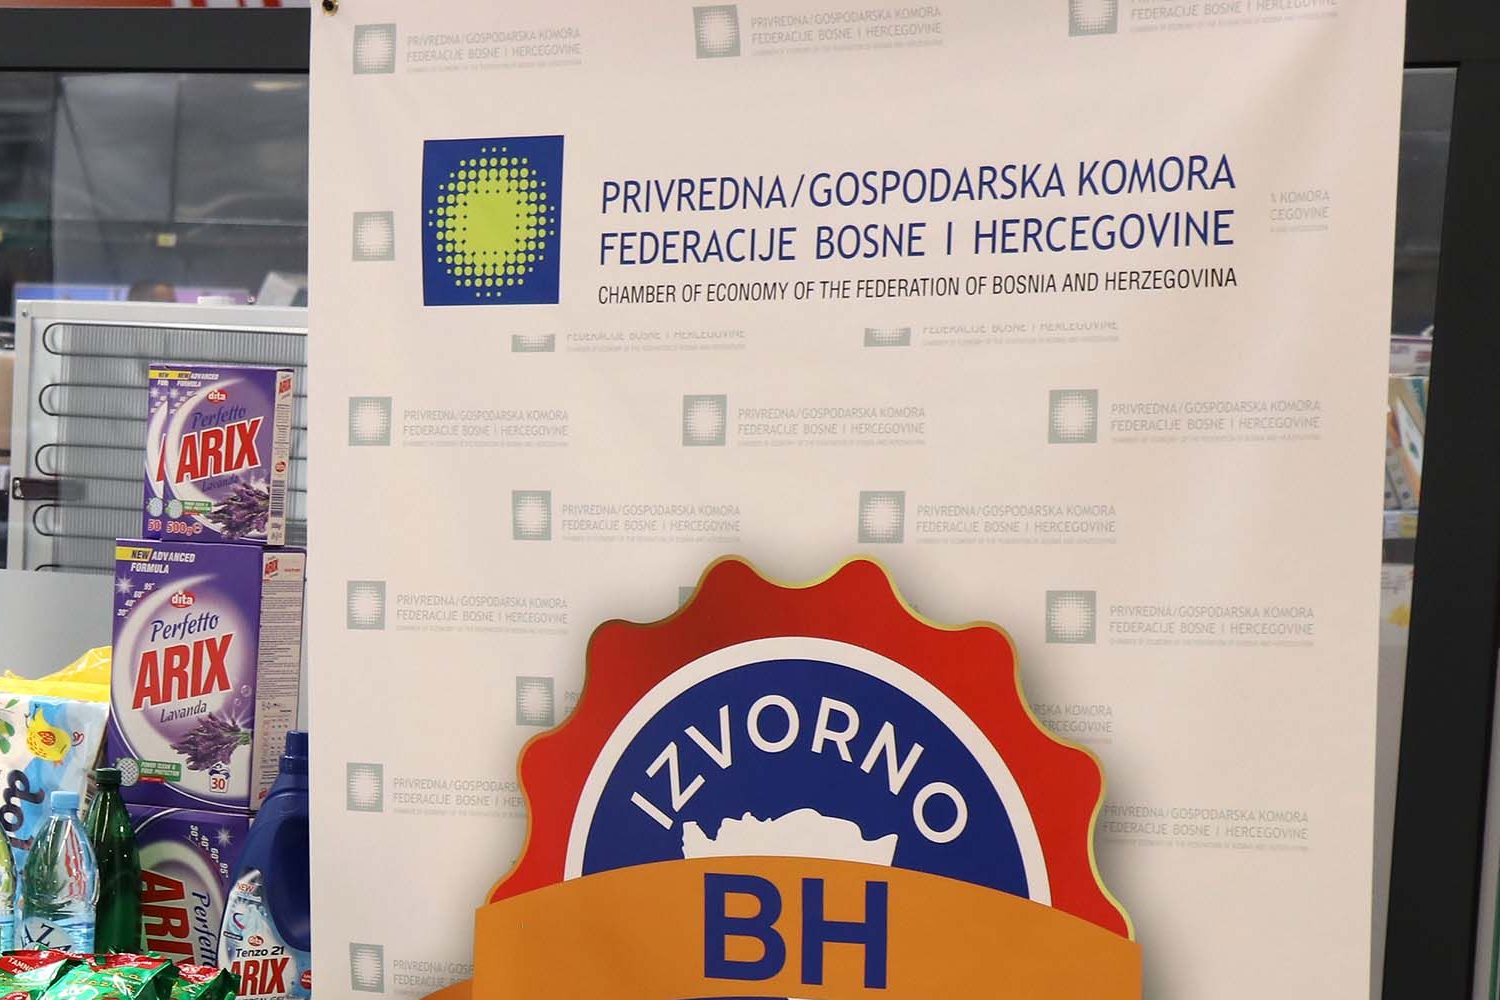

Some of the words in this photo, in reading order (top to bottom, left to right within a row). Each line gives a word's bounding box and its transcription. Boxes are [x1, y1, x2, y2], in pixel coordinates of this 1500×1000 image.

[602, 162, 1066, 214] PRIVREDNA/GOSPODARSKA
[1078, 153, 1236, 196] KOMORA
[600, 227, 797, 266] FEDERACIJE
[816, 222, 927, 260] BOSNE
[946, 221, 953, 256] I
[974, 209, 1235, 255] HERCEGOVINE
[598, 284, 676, 305] CHAMBER
[682, 283, 702, 303] OF
[707, 282, 789, 302] ECONOMY
[794, 281, 815, 300] OF
[819, 280, 852, 299] THE
[856, 277, 960, 298] FEDERATION
[965, 276, 988, 296] OF
[992, 274, 1057, 295] BOSNIA
[1061, 272, 1099, 292] AND
[1104, 267, 1237, 291] HERZEGOVINA
[191, 404, 246, 429] Perfetto
[175, 418, 262, 484] ARIX
[131, 549, 149, 559] NEW
[151, 552, 195, 563] ADVANCED
[131, 562, 169, 574] FORMULA
[172, 590, 193, 606] dita
[151, 611, 219, 642] Perfetto
[132, 633, 233, 710] ARIX
[160, 700, 208, 723] Lavanda
[211, 777, 226, 790] 30
[629, 694, 969, 844] IZVORNO
[141, 869, 195, 965] ARI
[703, 872, 889, 990] BH
[236, 948, 268, 958] Tenzo
[271, 946, 285, 956] 21
